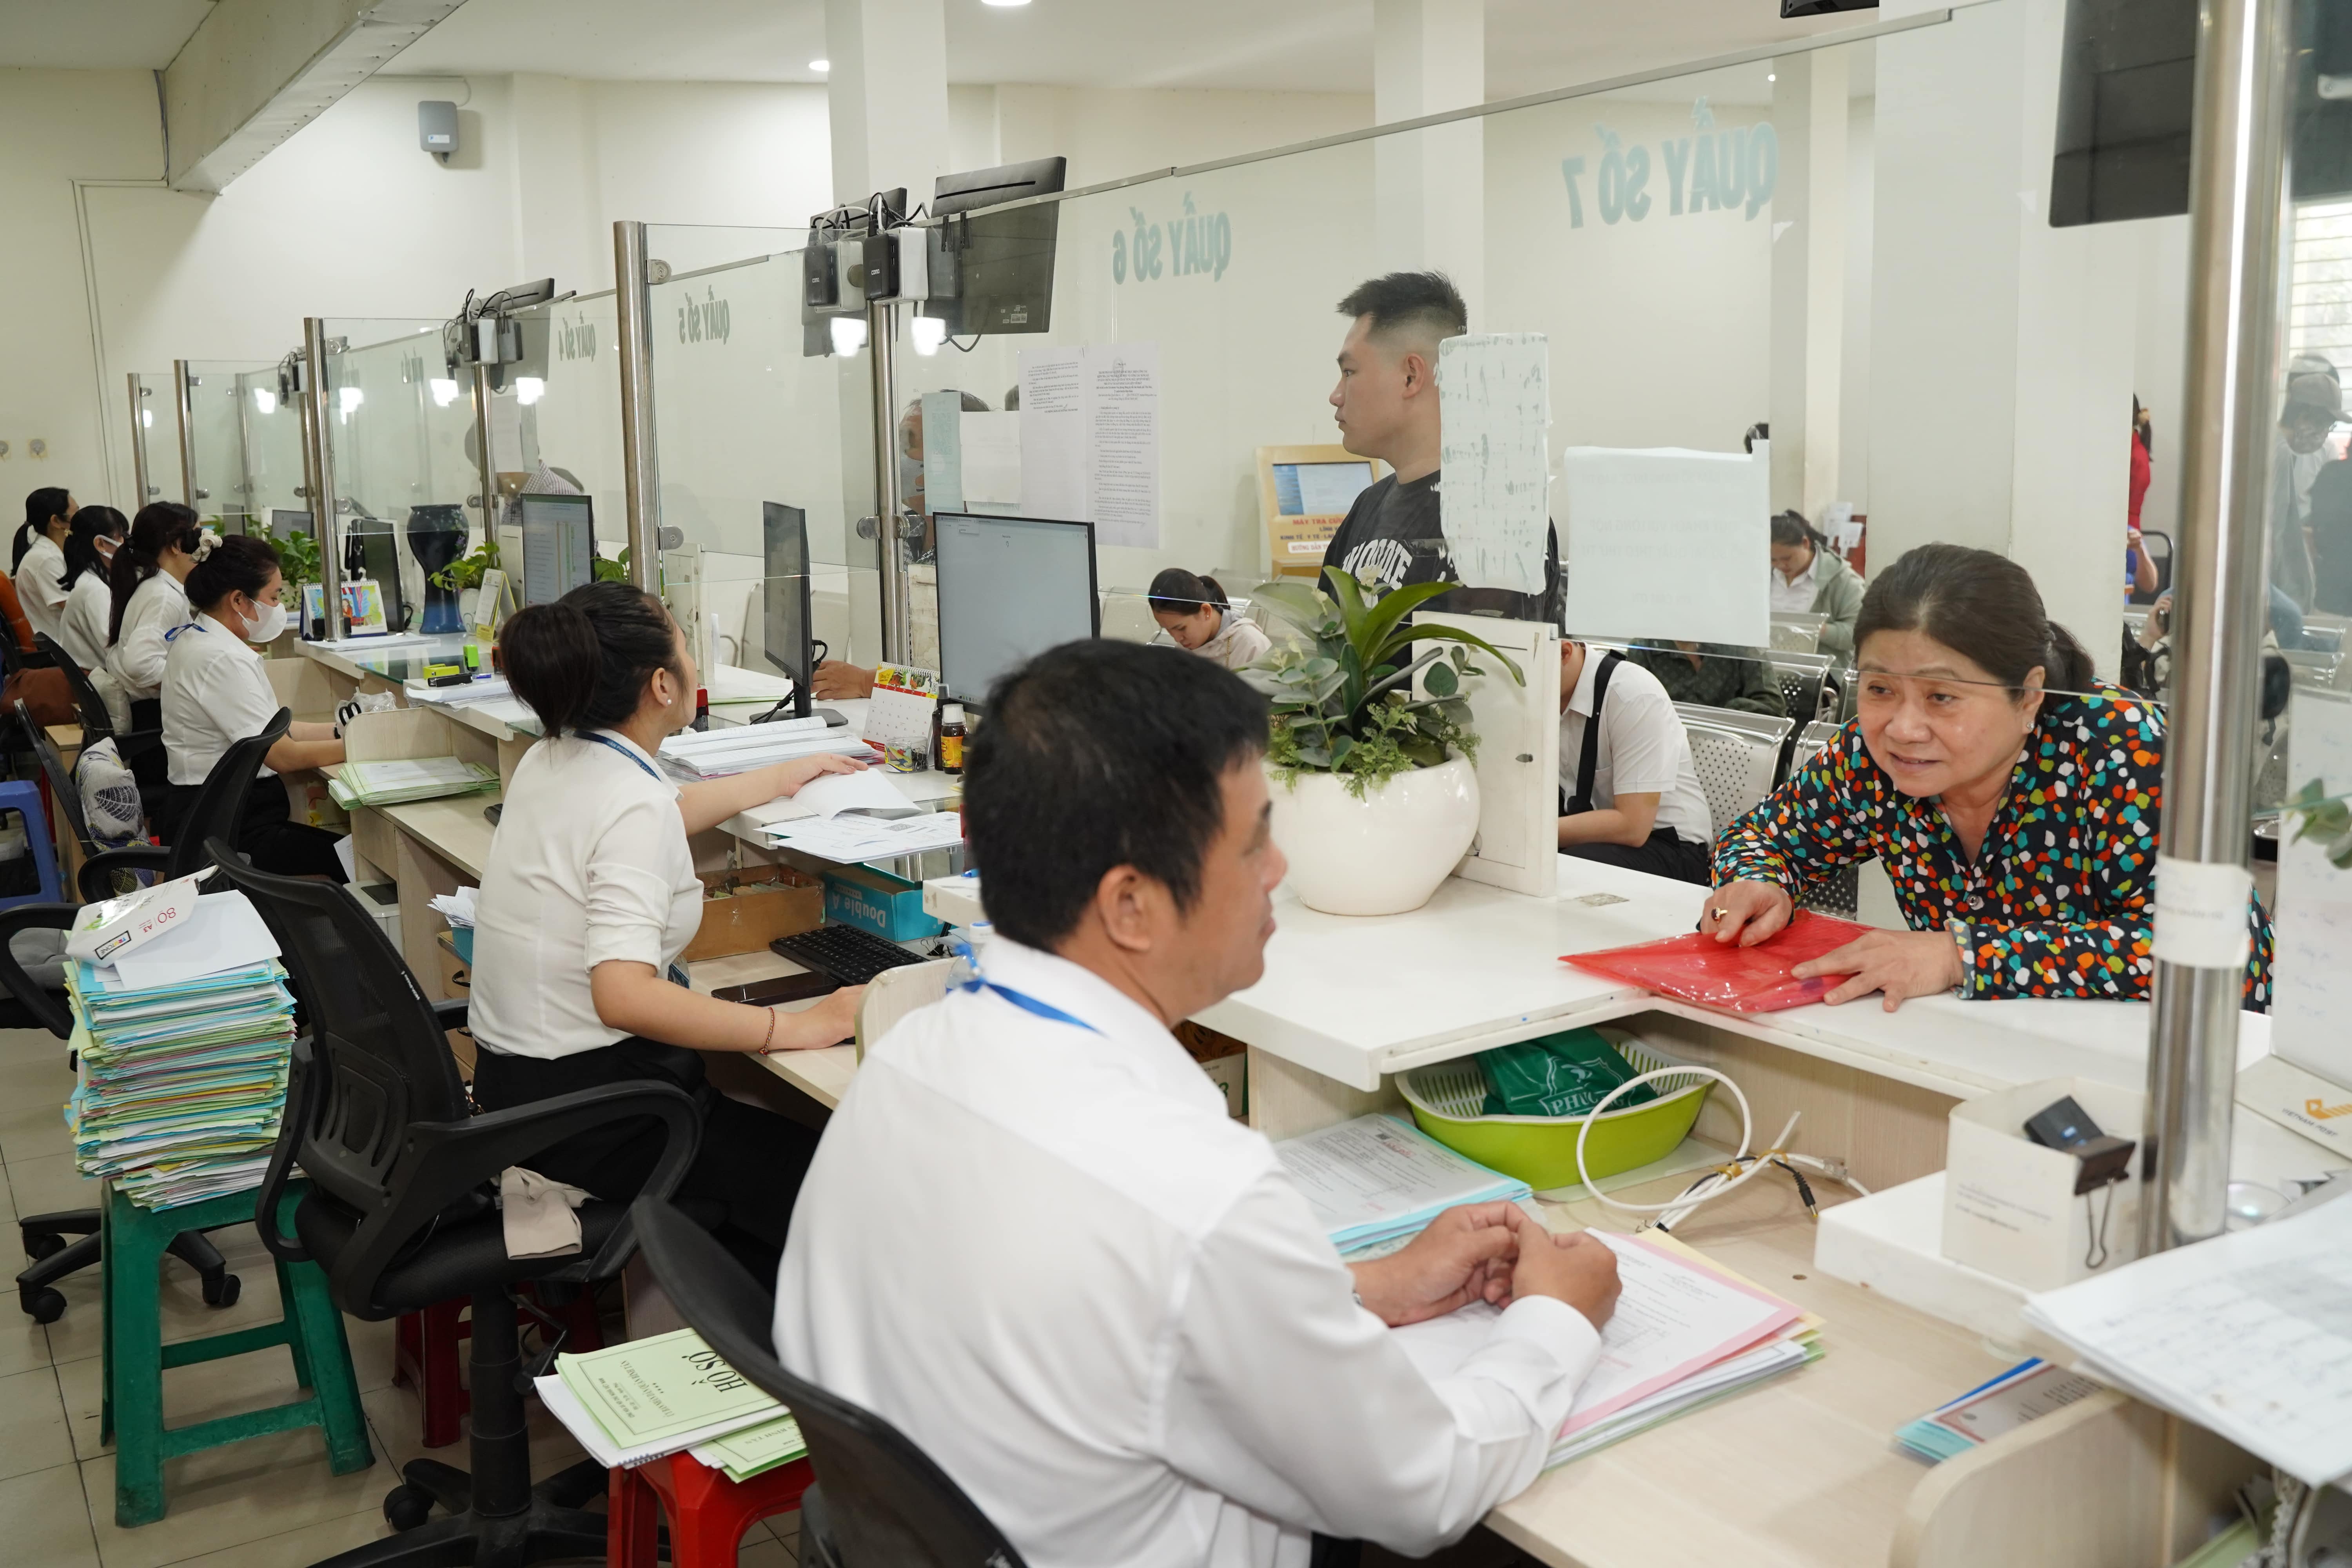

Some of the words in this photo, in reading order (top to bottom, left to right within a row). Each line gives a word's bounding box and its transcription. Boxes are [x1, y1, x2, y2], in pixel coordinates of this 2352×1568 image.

[832, 893, 841, 910] A
[158, 907, 176, 923] 80
[845, 897, 886, 928] Double
[143, 924, 152, 933] A3
[2282, 1108, 2314, 1126] VIETNAM
[681, 1351, 728, 1371] SƠ
[691, 1370, 748, 1393] HỒ
